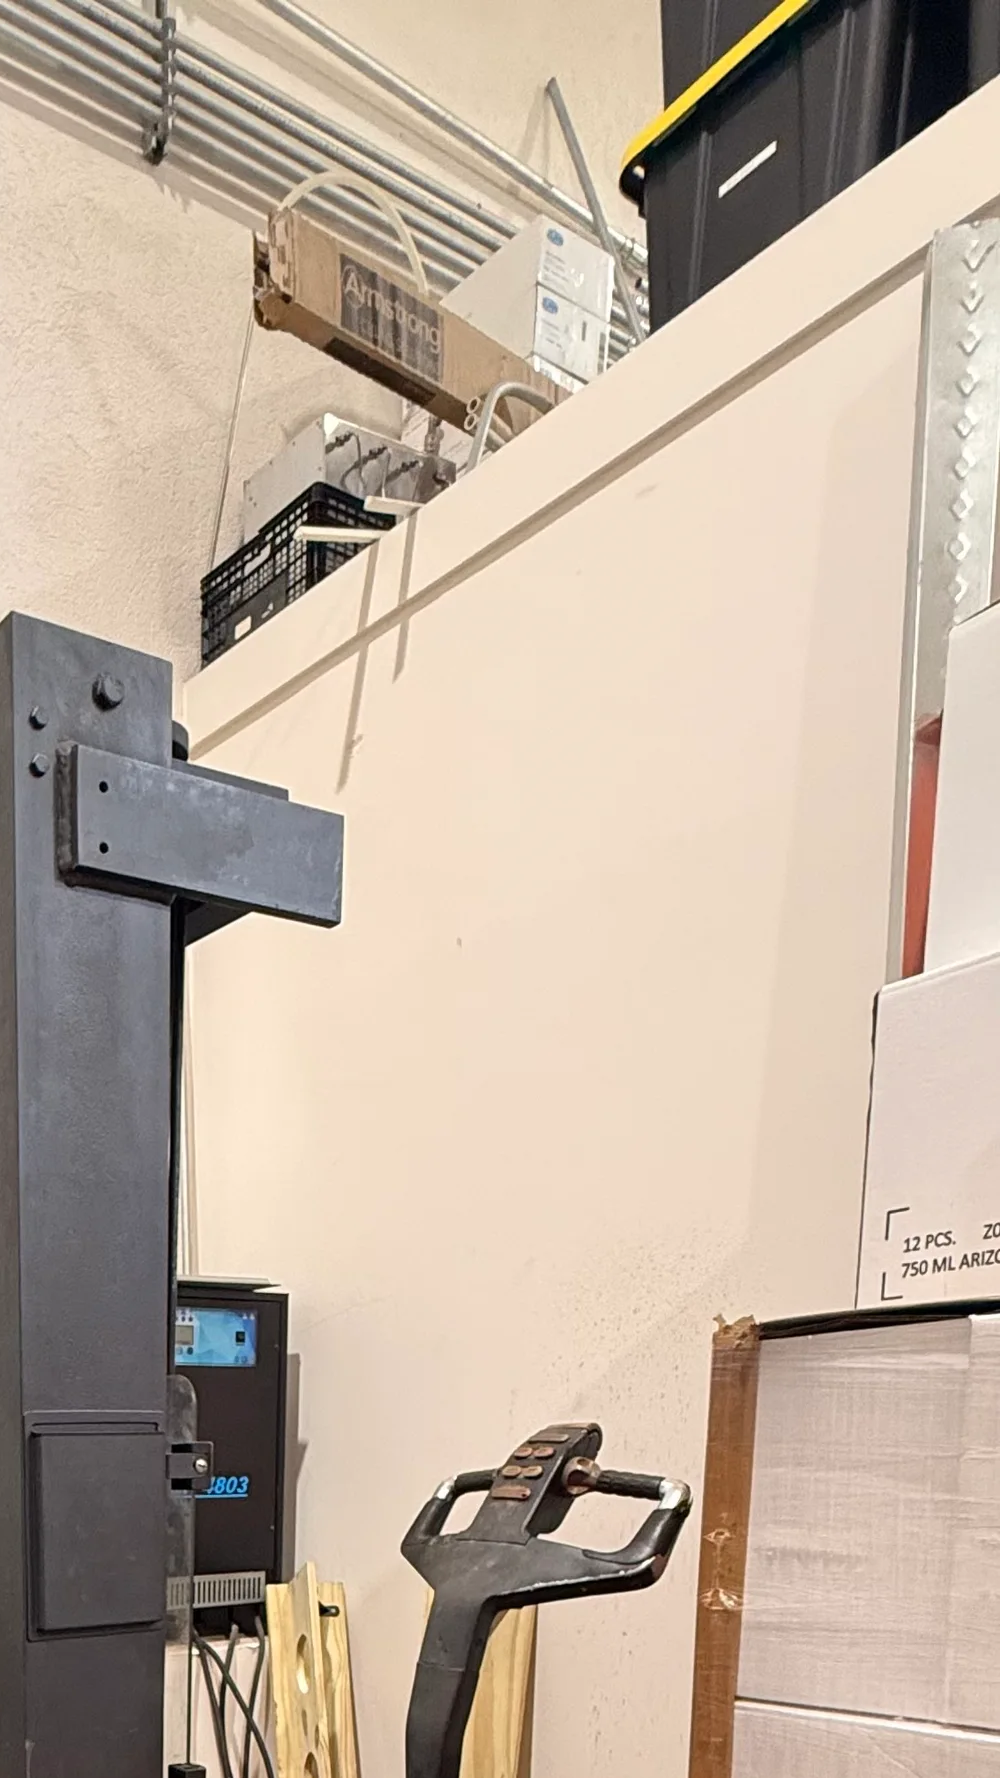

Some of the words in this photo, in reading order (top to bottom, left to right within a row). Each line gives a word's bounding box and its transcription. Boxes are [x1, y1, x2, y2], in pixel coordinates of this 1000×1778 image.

[903, 1236, 921, 1253] 12
[925, 1230, 956, 1250] PCS.
[901, 1259, 928, 1278] 750
[932, 1255, 955, 1274] ML
